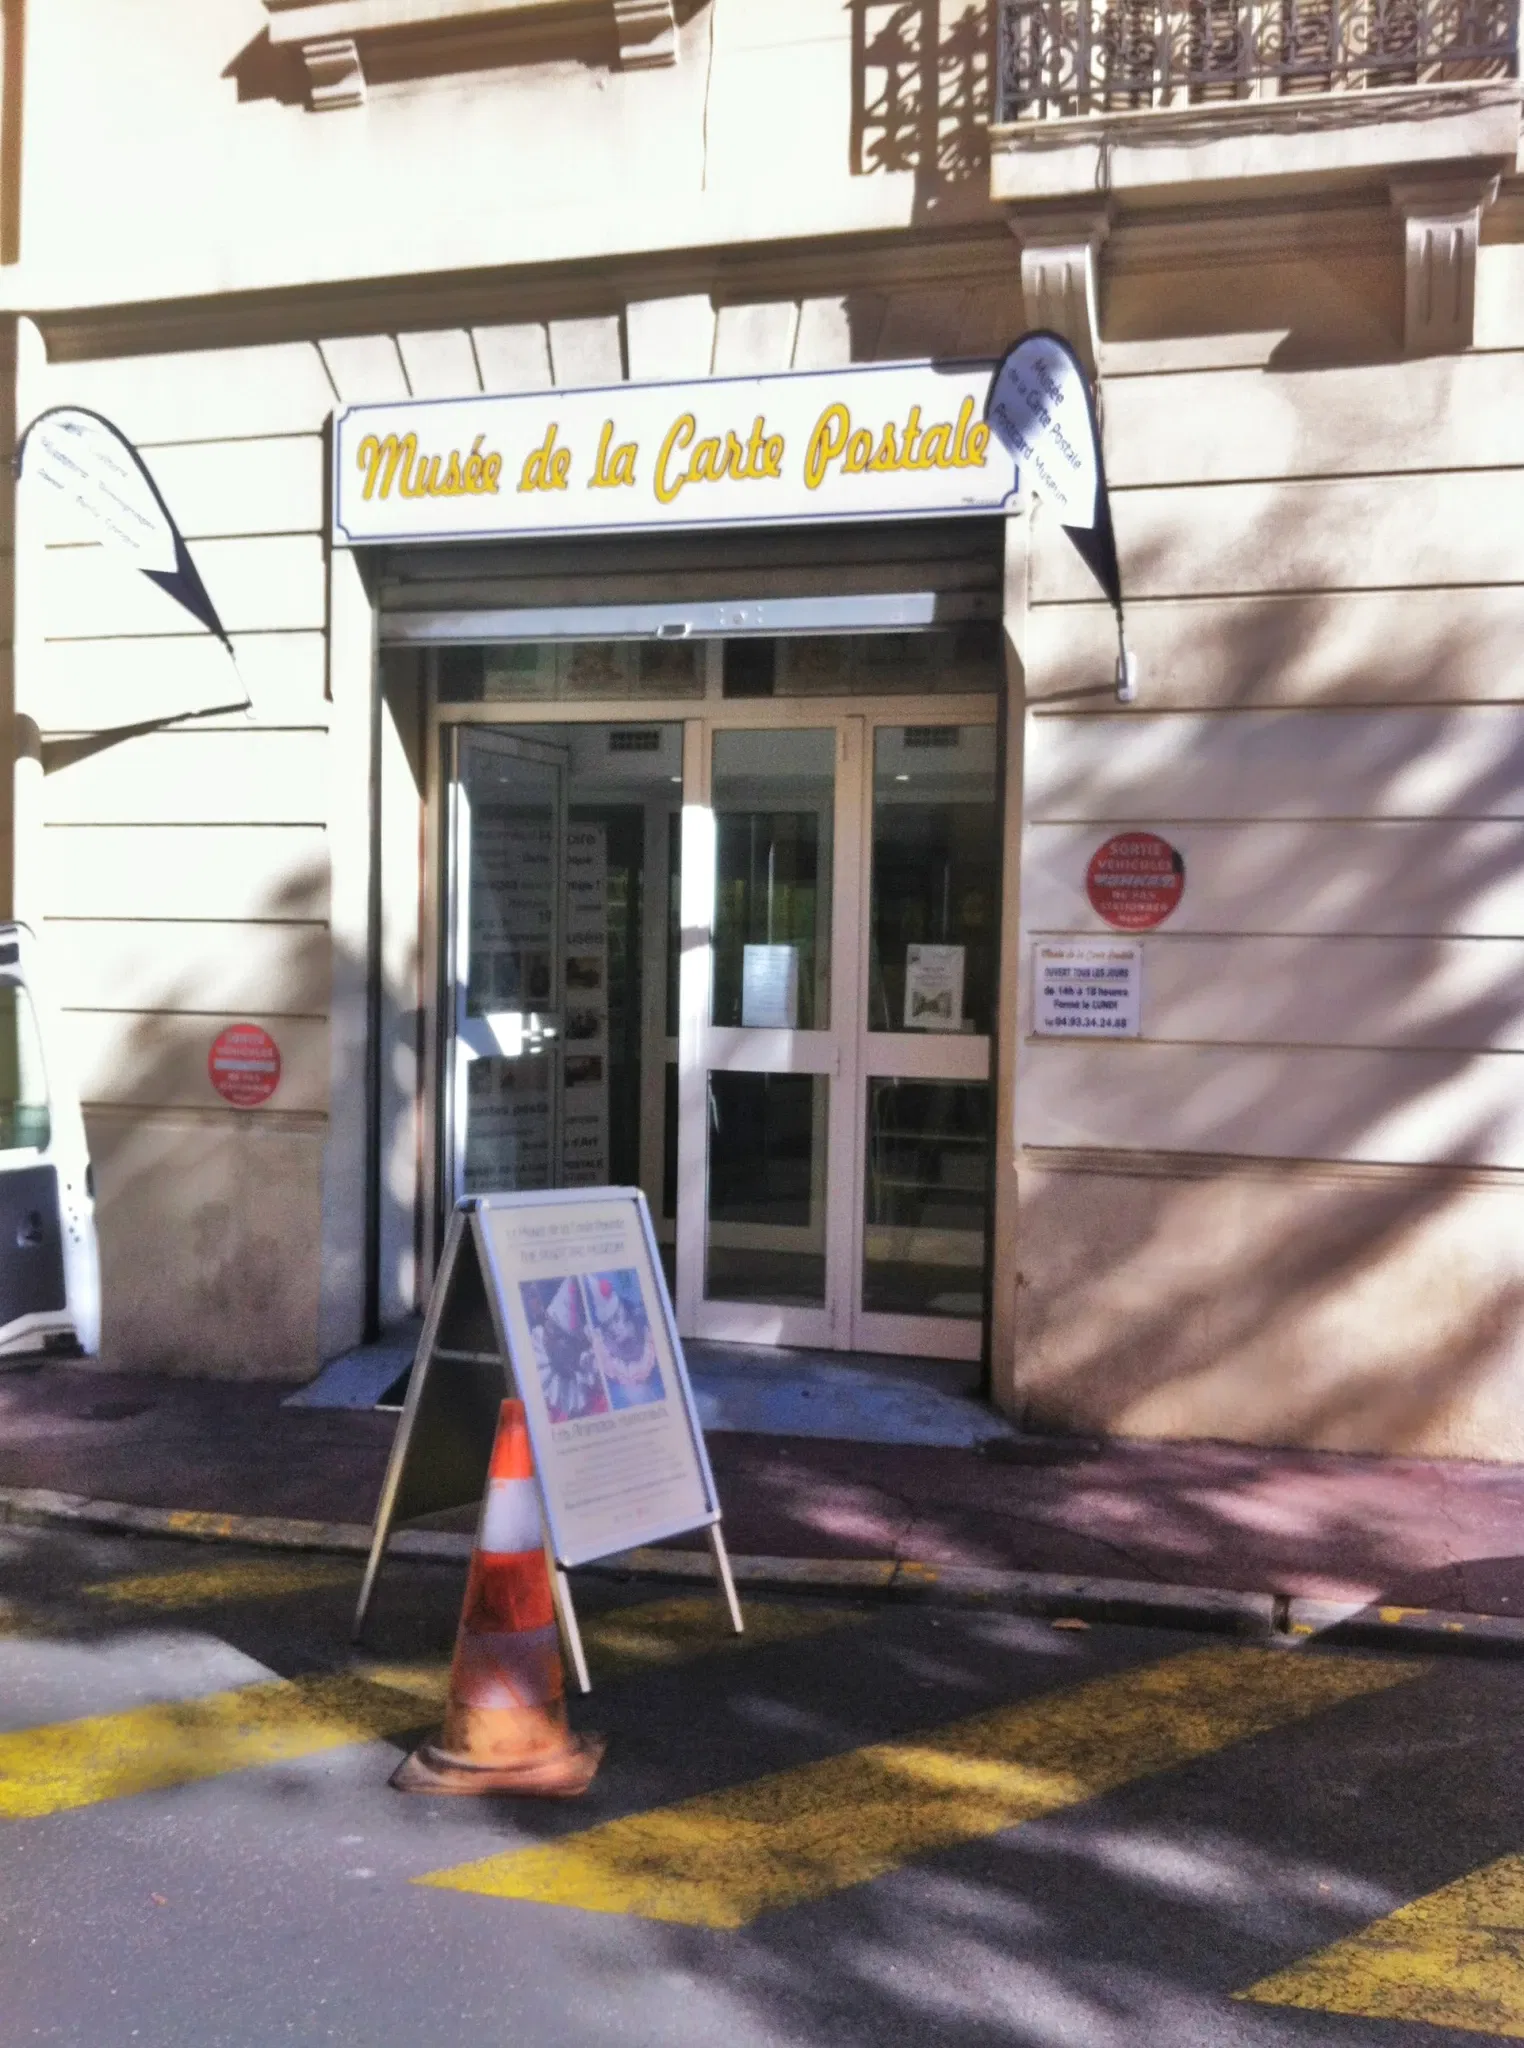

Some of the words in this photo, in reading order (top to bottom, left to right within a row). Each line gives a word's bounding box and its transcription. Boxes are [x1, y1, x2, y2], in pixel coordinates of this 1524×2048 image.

[1032, 357, 1065, 407] Musée
[356, 431, 502, 501] Musée
[516, 421, 572, 493] de
[586, 418, 639, 489] la
[653, 412, 785, 505] Carte
[803, 394, 991, 491] Postale
[1050, 422, 1083, 471] Postale
[1044, 967, 1071, 977] OUVERT
